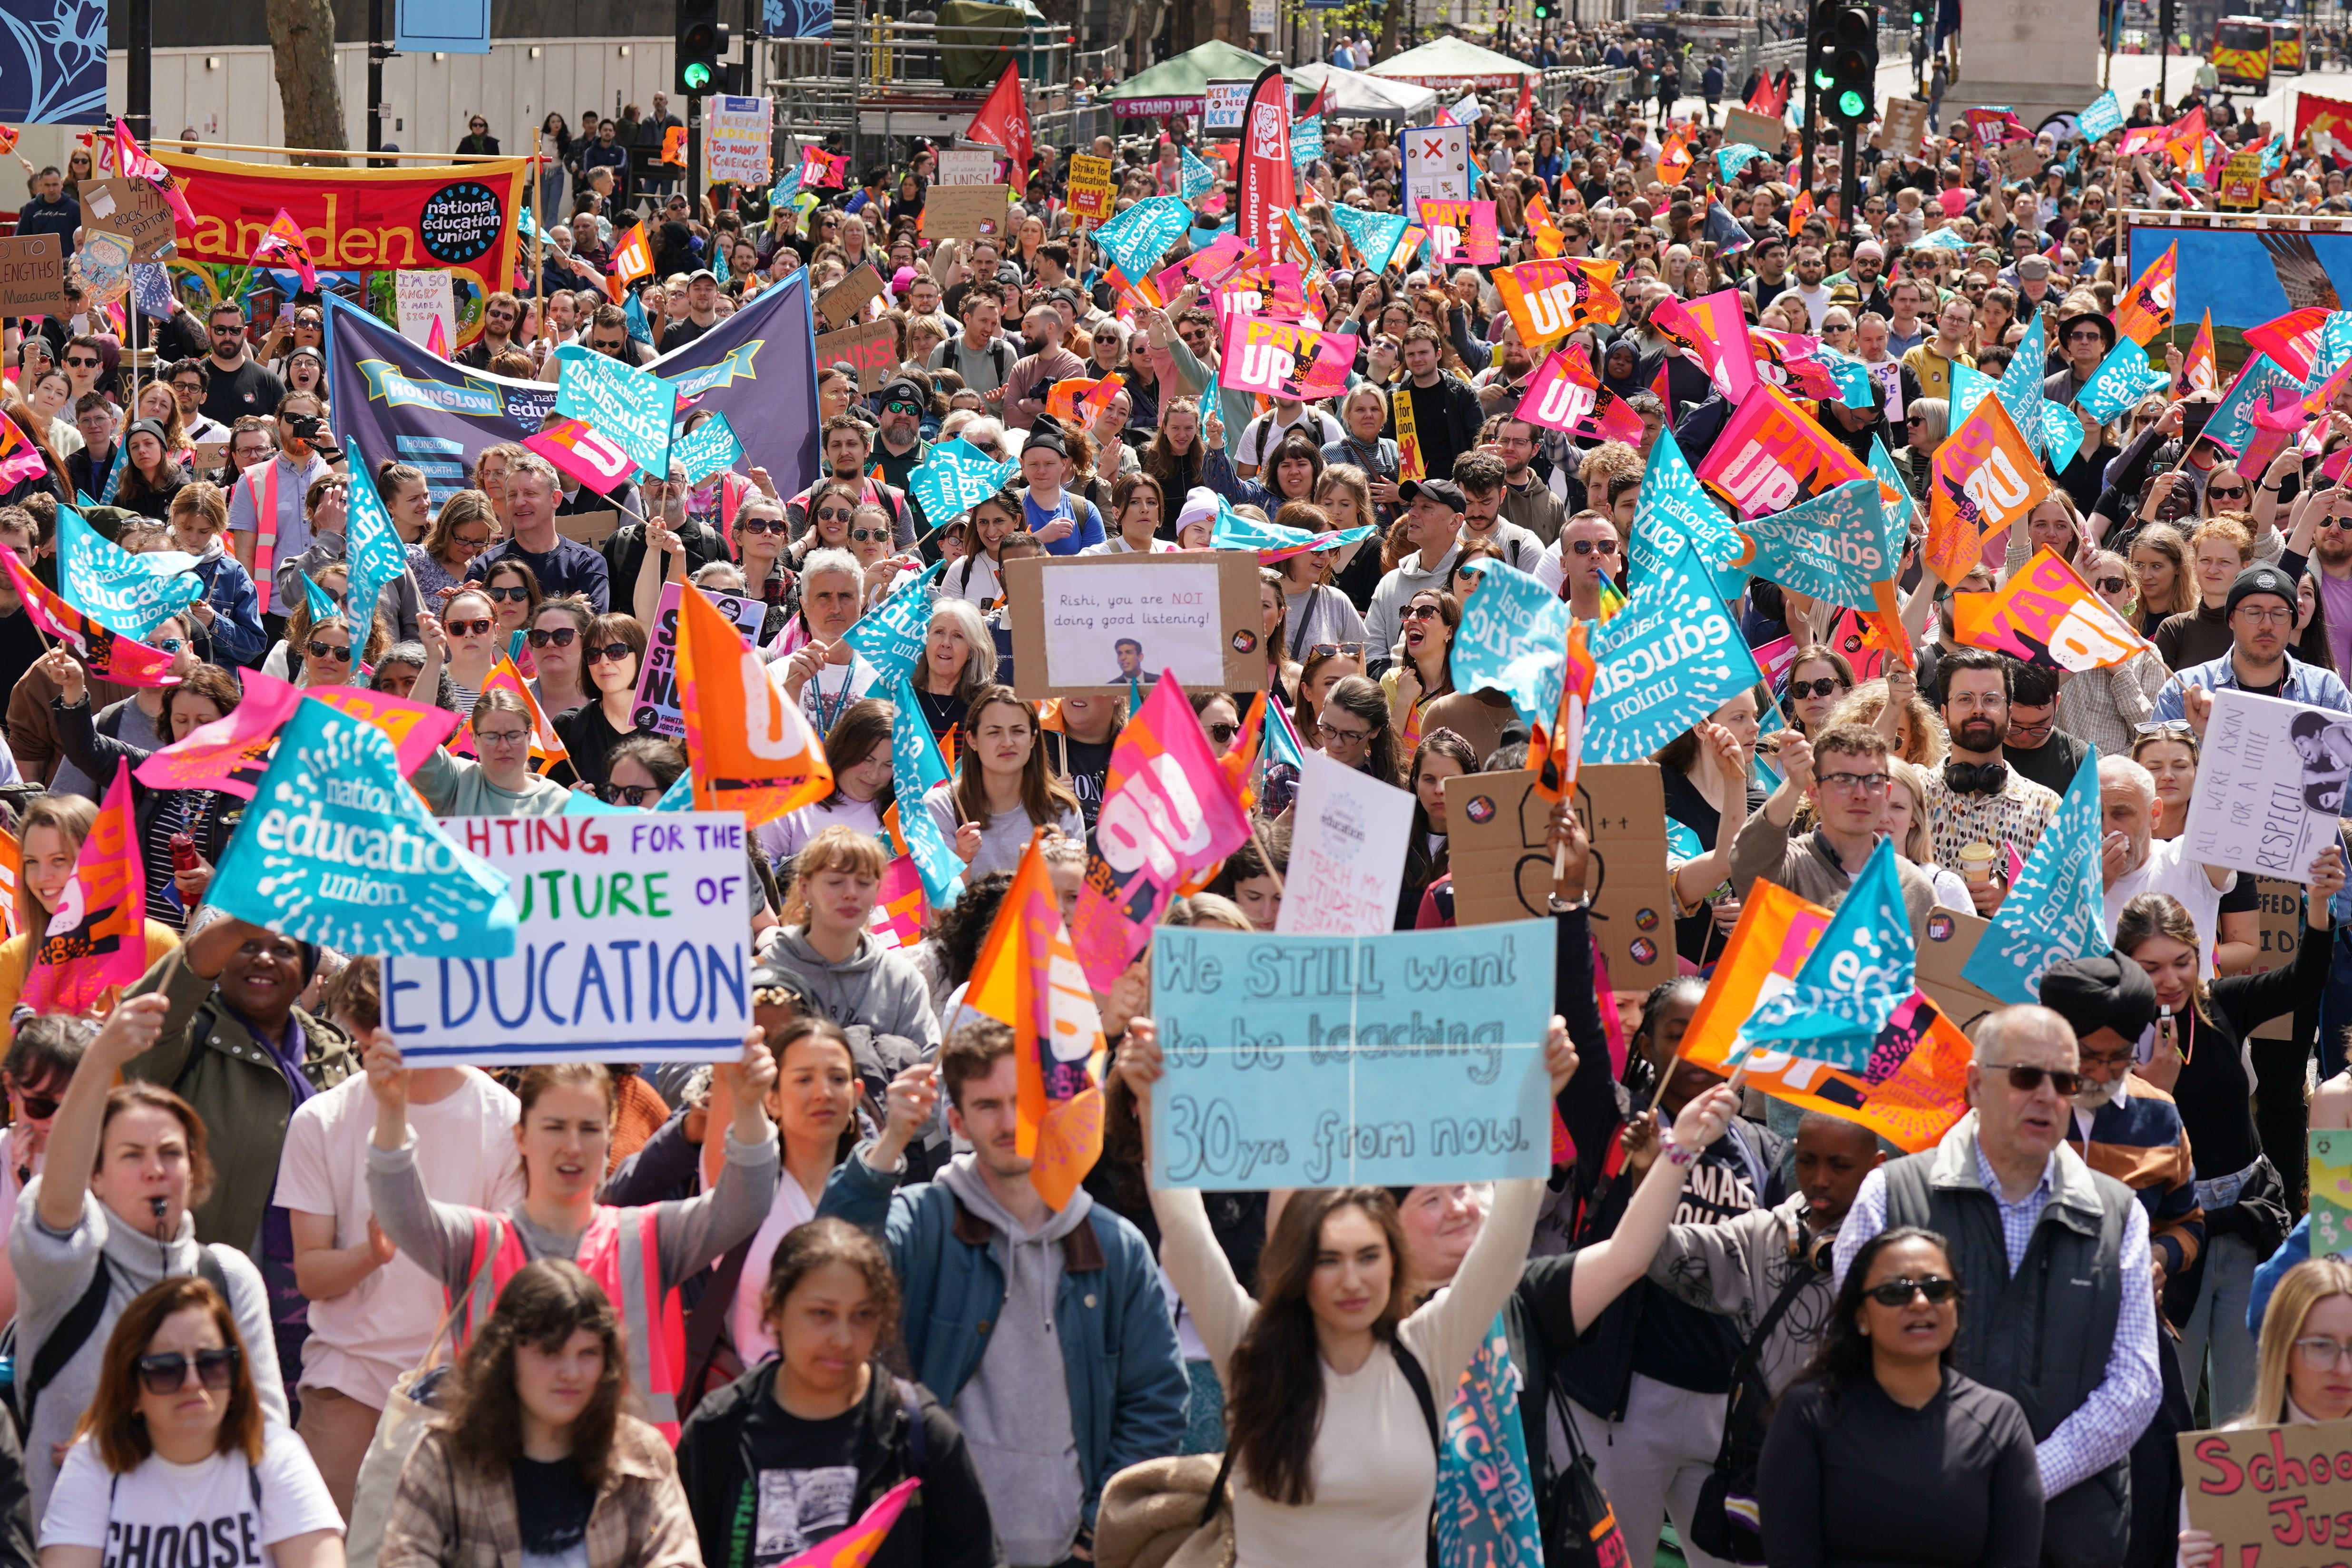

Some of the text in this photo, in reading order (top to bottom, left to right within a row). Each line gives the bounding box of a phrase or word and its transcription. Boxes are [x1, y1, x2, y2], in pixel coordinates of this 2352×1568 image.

[1130, 100, 1194, 114] STAND UP
[1207, 110, 1236, 125] KEY
[730, 145, 759, 156] MANY
[940, 151, 987, 162] TEACHERS
[1073, 162, 1108, 176] Strike for
[127, 179, 144, 192] WE
[1071, 174, 1107, 187] education
[138, 193, 162, 210] HIT
[427, 197, 496, 215] national
[115, 210, 143, 229] ROCK
[422, 213, 501, 230] education
[1112, 204, 1146, 242] national
[1421, 203, 1471, 226] PAY
[437, 229, 481, 243] union
[1116, 196, 1174, 266] education
[1139, 224, 1162, 252] union
[19, 240, 46, 256] TO
[97, 241, 123, 257] NOISY
[1460, 235, 1496, 247] education
[93, 247, 118, 265] POEMS
[0, 259, 59, 284] ENGTHS!
[399, 274, 448, 287] I'M SO
[399, 288, 439, 300] ANGRY
[842, 277, 863, 296] OUR
[3, 289, 61, 305] Measures
[437, 301, 443, 309] A
[1577, 287, 1619, 307] education
[406, 312, 434, 321] SIGN
[831, 326, 891, 350] just have
[1247, 321, 1323, 358] PAY
[1294, 367, 1336, 389] education
[390, 381, 493, 411] HOUNSLOW
[532, 393, 557, 402] nati
[1399, 403, 1410, 418] for
[1595, 403, 1642, 429] education
[406, 439, 452, 449] HOUNSLOW
[1755, 408, 1848, 495] PAY
[208, 453, 219, 461] BE
[1660, 493, 1719, 542] national
[1059, 592, 1204, 611] Rishi, you are NOT
[113, 601, 171, 631] union
[1054, 612, 1210, 631] doing good listening!
[1238, 632, 1254, 641] PAY
[658, 723, 686, 734] JOBS PAY
[2196, 703, 2245, 856] ALL WE'RE ASKIN'
[1477, 796, 1493, 812] PAY
[2223, 730, 2271, 862] IS FOR A LITTLE
[257, 800, 459, 874] educatio
[1320, 814, 1365, 842] education
[2256, 782, 2303, 873] RESPECT!
[632, 824, 685, 854] FOR
[694, 823, 741, 851] THE
[319, 872, 408, 905] union
[696, 875, 742, 906] OF
[1360, 872, 1388, 896] MY
[1931, 918, 1949, 926] PAY
[1638, 938, 1655, 954] PAY
[1158, 934, 1518, 998] We STILL want
[386, 940, 746, 1035] EDUCATION
[1164, 1011, 1505, 1085] to be teaching
[1889, 1087, 1927, 1114] union
[1303, 1109, 1415, 1185] from
[1430, 1117, 1530, 1158] now.
[106, 1512, 260, 1568] CHOOSE
